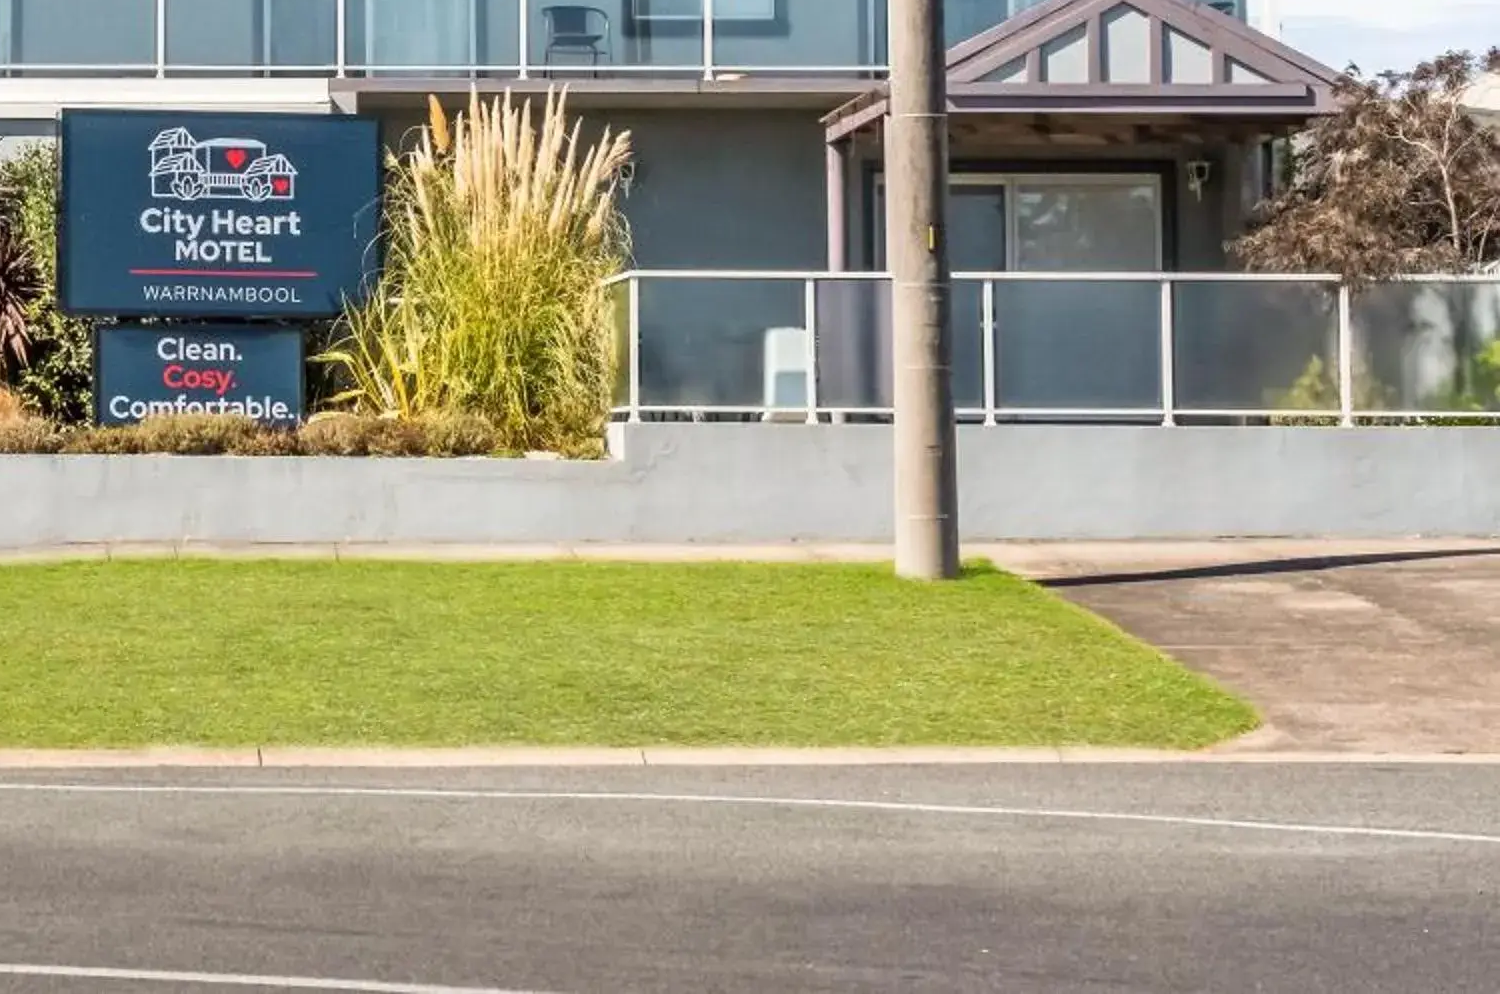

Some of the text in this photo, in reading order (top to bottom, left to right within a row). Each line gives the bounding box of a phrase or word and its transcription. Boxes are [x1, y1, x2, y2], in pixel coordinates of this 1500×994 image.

[139, 206, 301, 240] City Heart
[174, 239, 273, 263] MOTEL
[143, 285, 302, 303] WARRNAMBOOL
[157, 337, 243, 360] Clean.
[163, 363, 237, 395] Cosy.
[109, 394, 295, 419] Comfortable.
